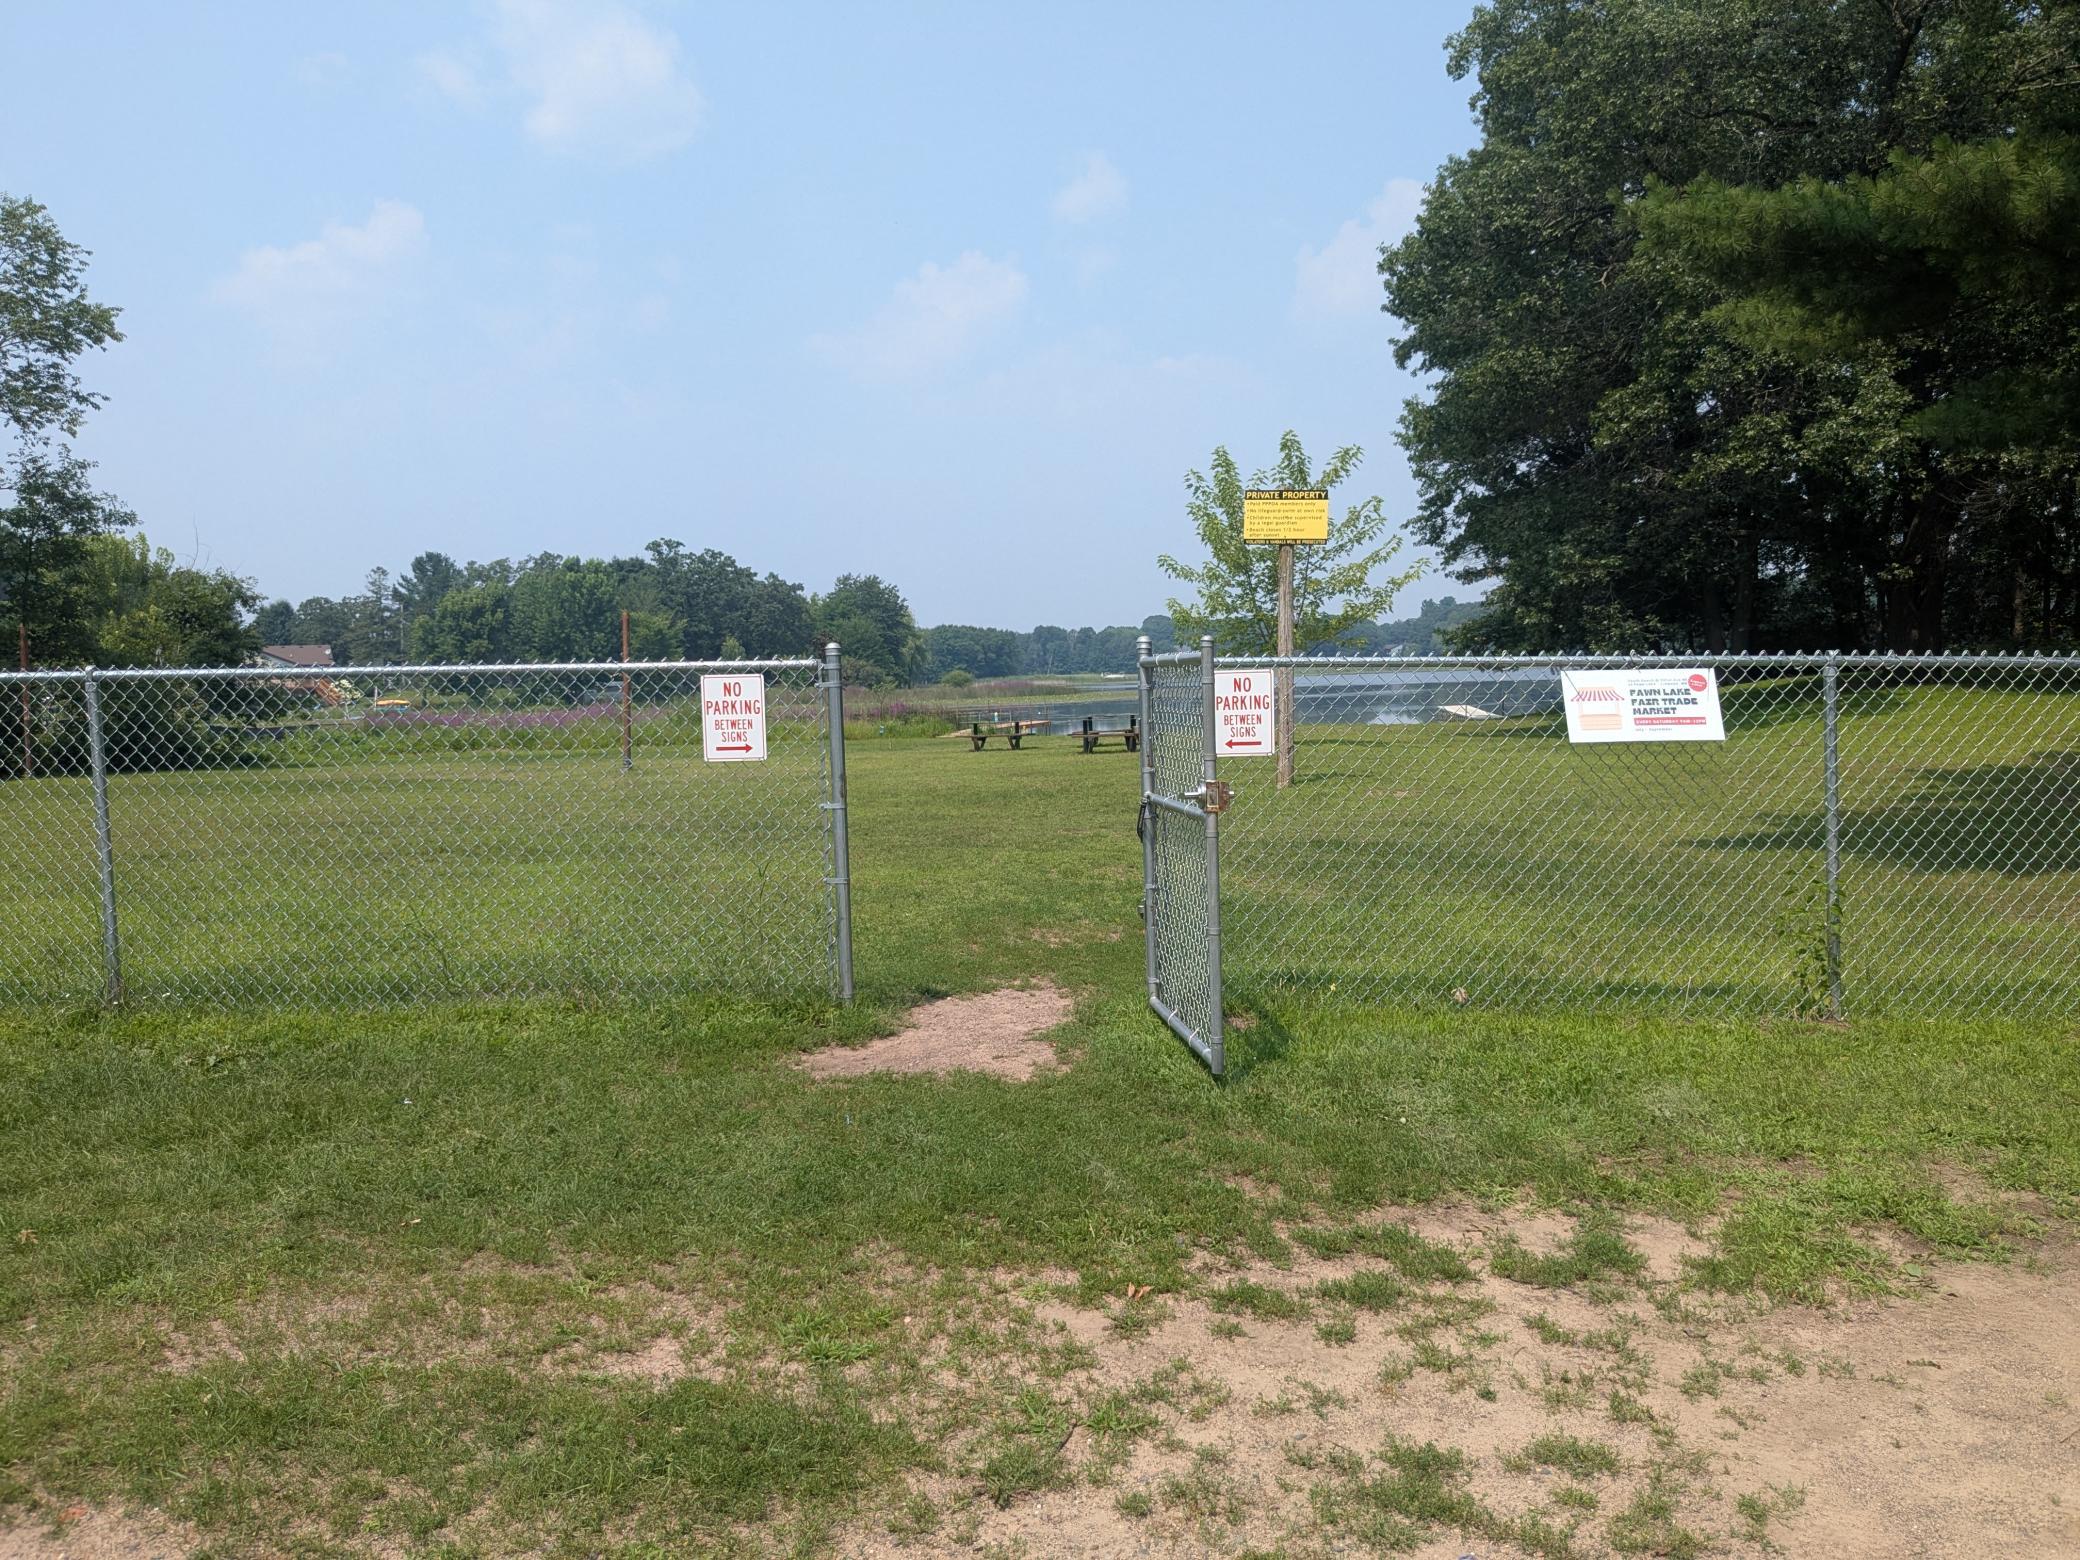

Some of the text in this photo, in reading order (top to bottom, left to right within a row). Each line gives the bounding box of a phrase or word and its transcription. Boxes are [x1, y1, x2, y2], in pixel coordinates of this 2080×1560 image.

[1246, 491, 1327, 499] PRIVATE PROPERTY
[723, 682, 742, 697] NO
[1233, 677, 1252, 692] NO
[1629, 687, 1692, 697] FAWN LAKE
[706, 699, 761, 715] PARKING
[1216, 694, 1270, 710] PARKING
[1631, 697, 1699, 707] FAIR TRADE
[1633, 707, 1678, 715] MARKET
[714, 719, 753, 730] BETWEEN
[1223, 714, 1262, 725] BETWEEN
[721, 731, 748, 742] SIGNS
[1230, 726, 1257, 738] SIGNS
